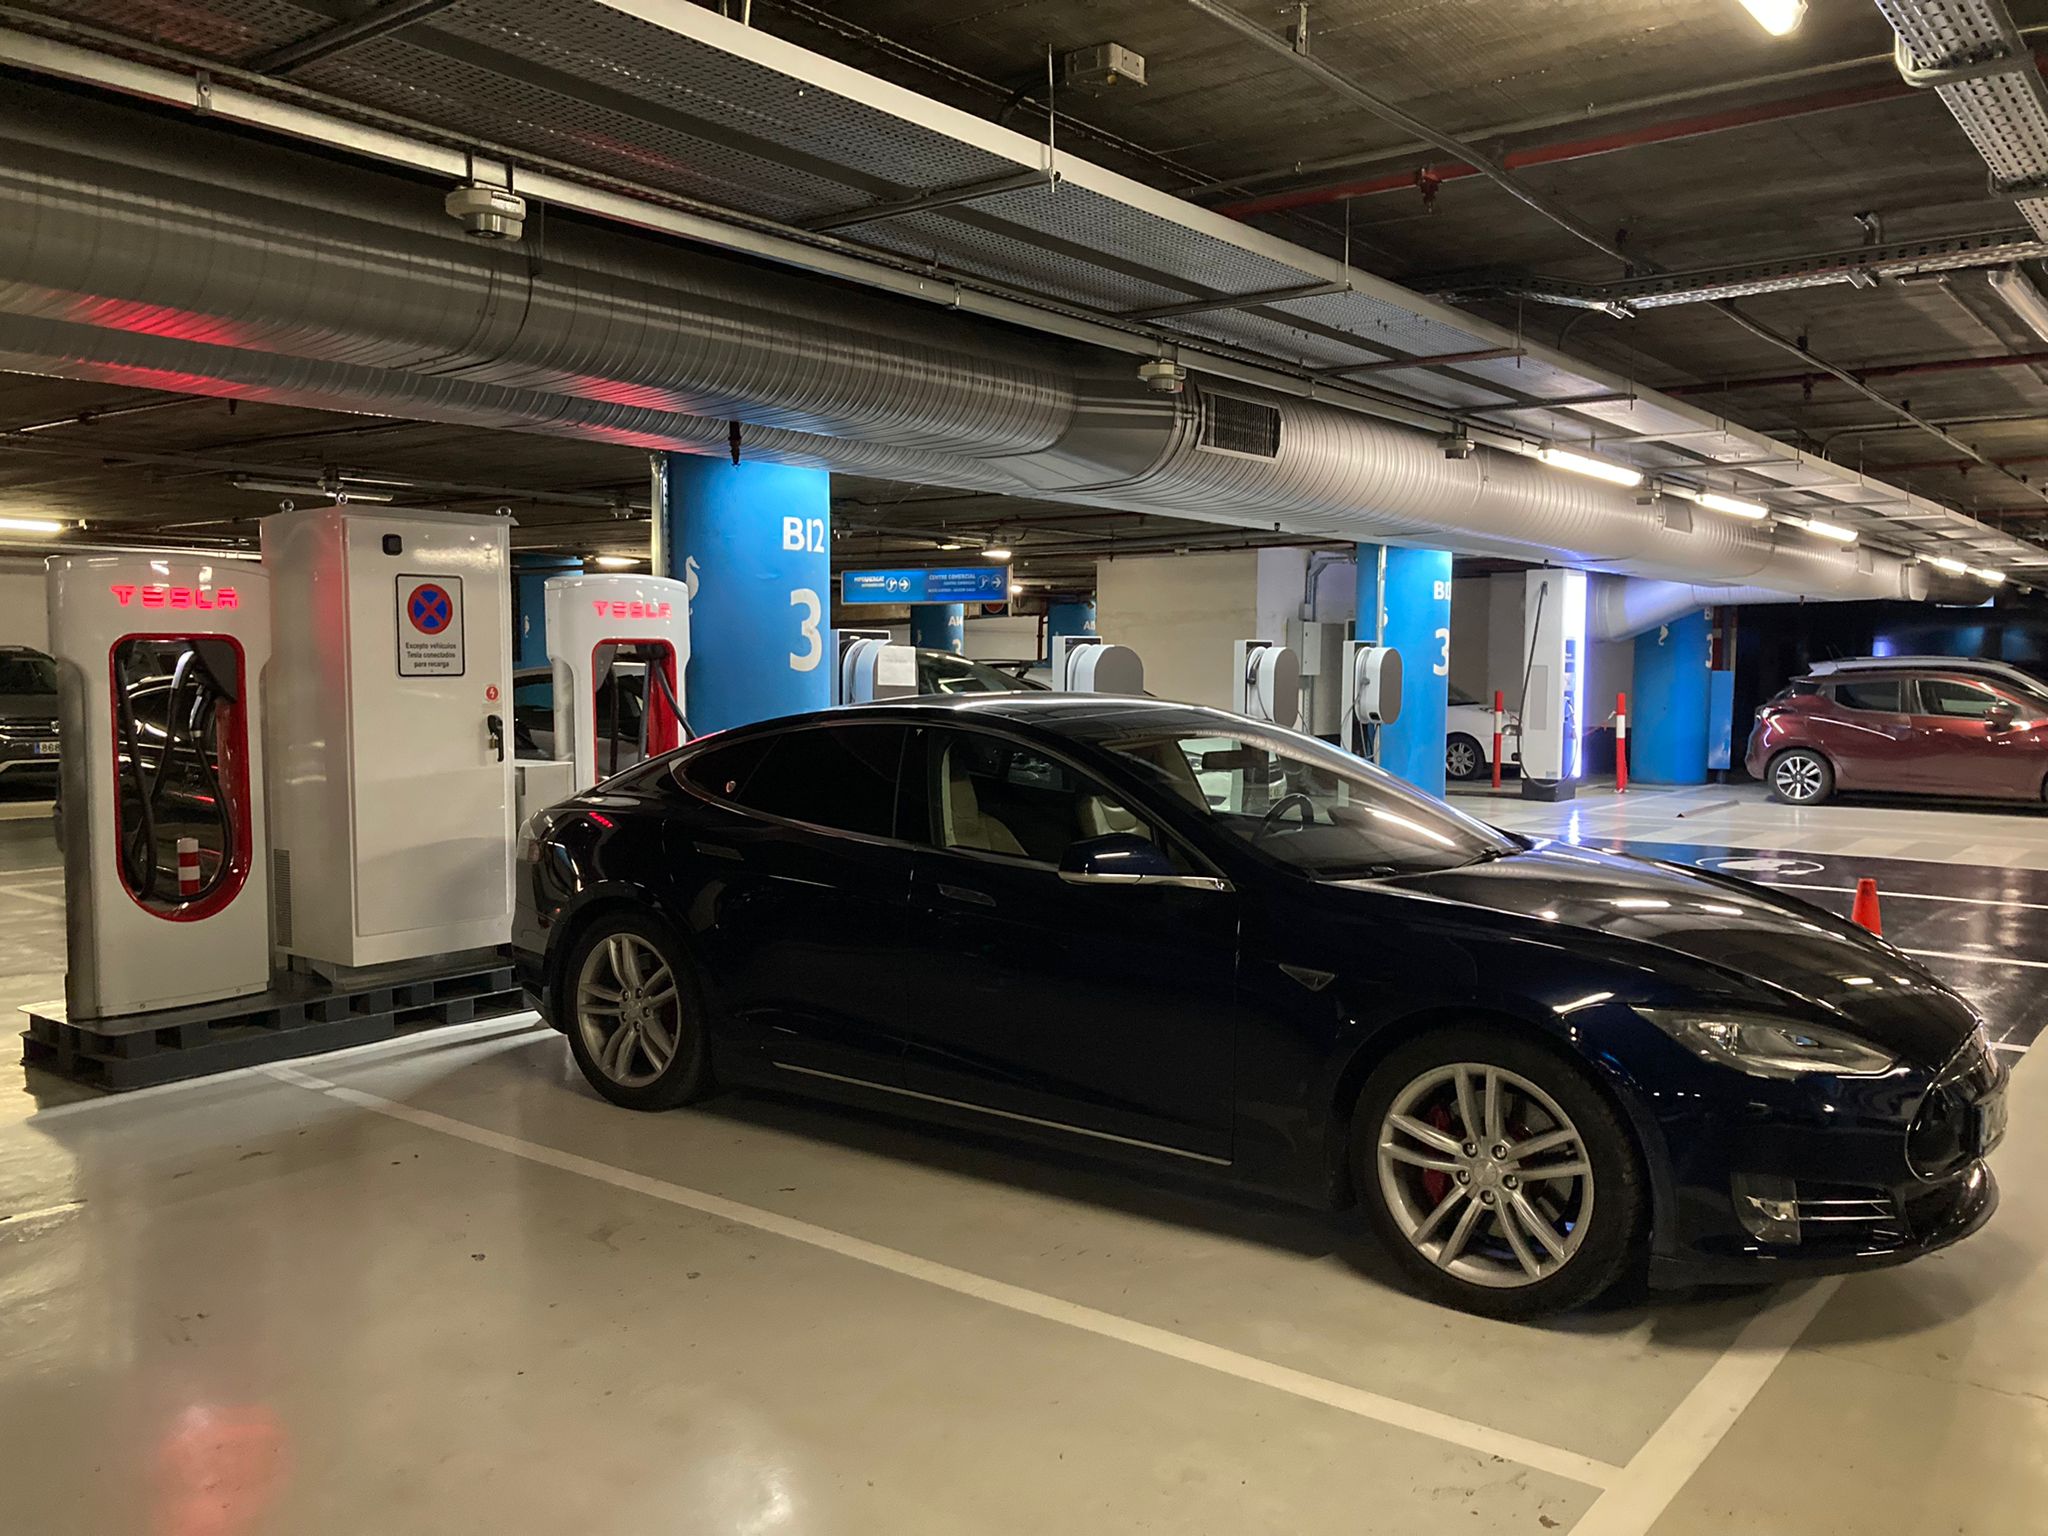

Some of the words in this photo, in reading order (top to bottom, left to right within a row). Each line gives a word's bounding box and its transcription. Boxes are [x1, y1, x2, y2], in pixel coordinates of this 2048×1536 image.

[782, 516, 825, 553] B12
[110, 585, 238, 610] TESLA
[592, 600, 672, 618] TESLA
[789, 588, 822, 672] 3
[405, 642, 429, 650] Excepto
[1433, 628, 1450, 676] 3
